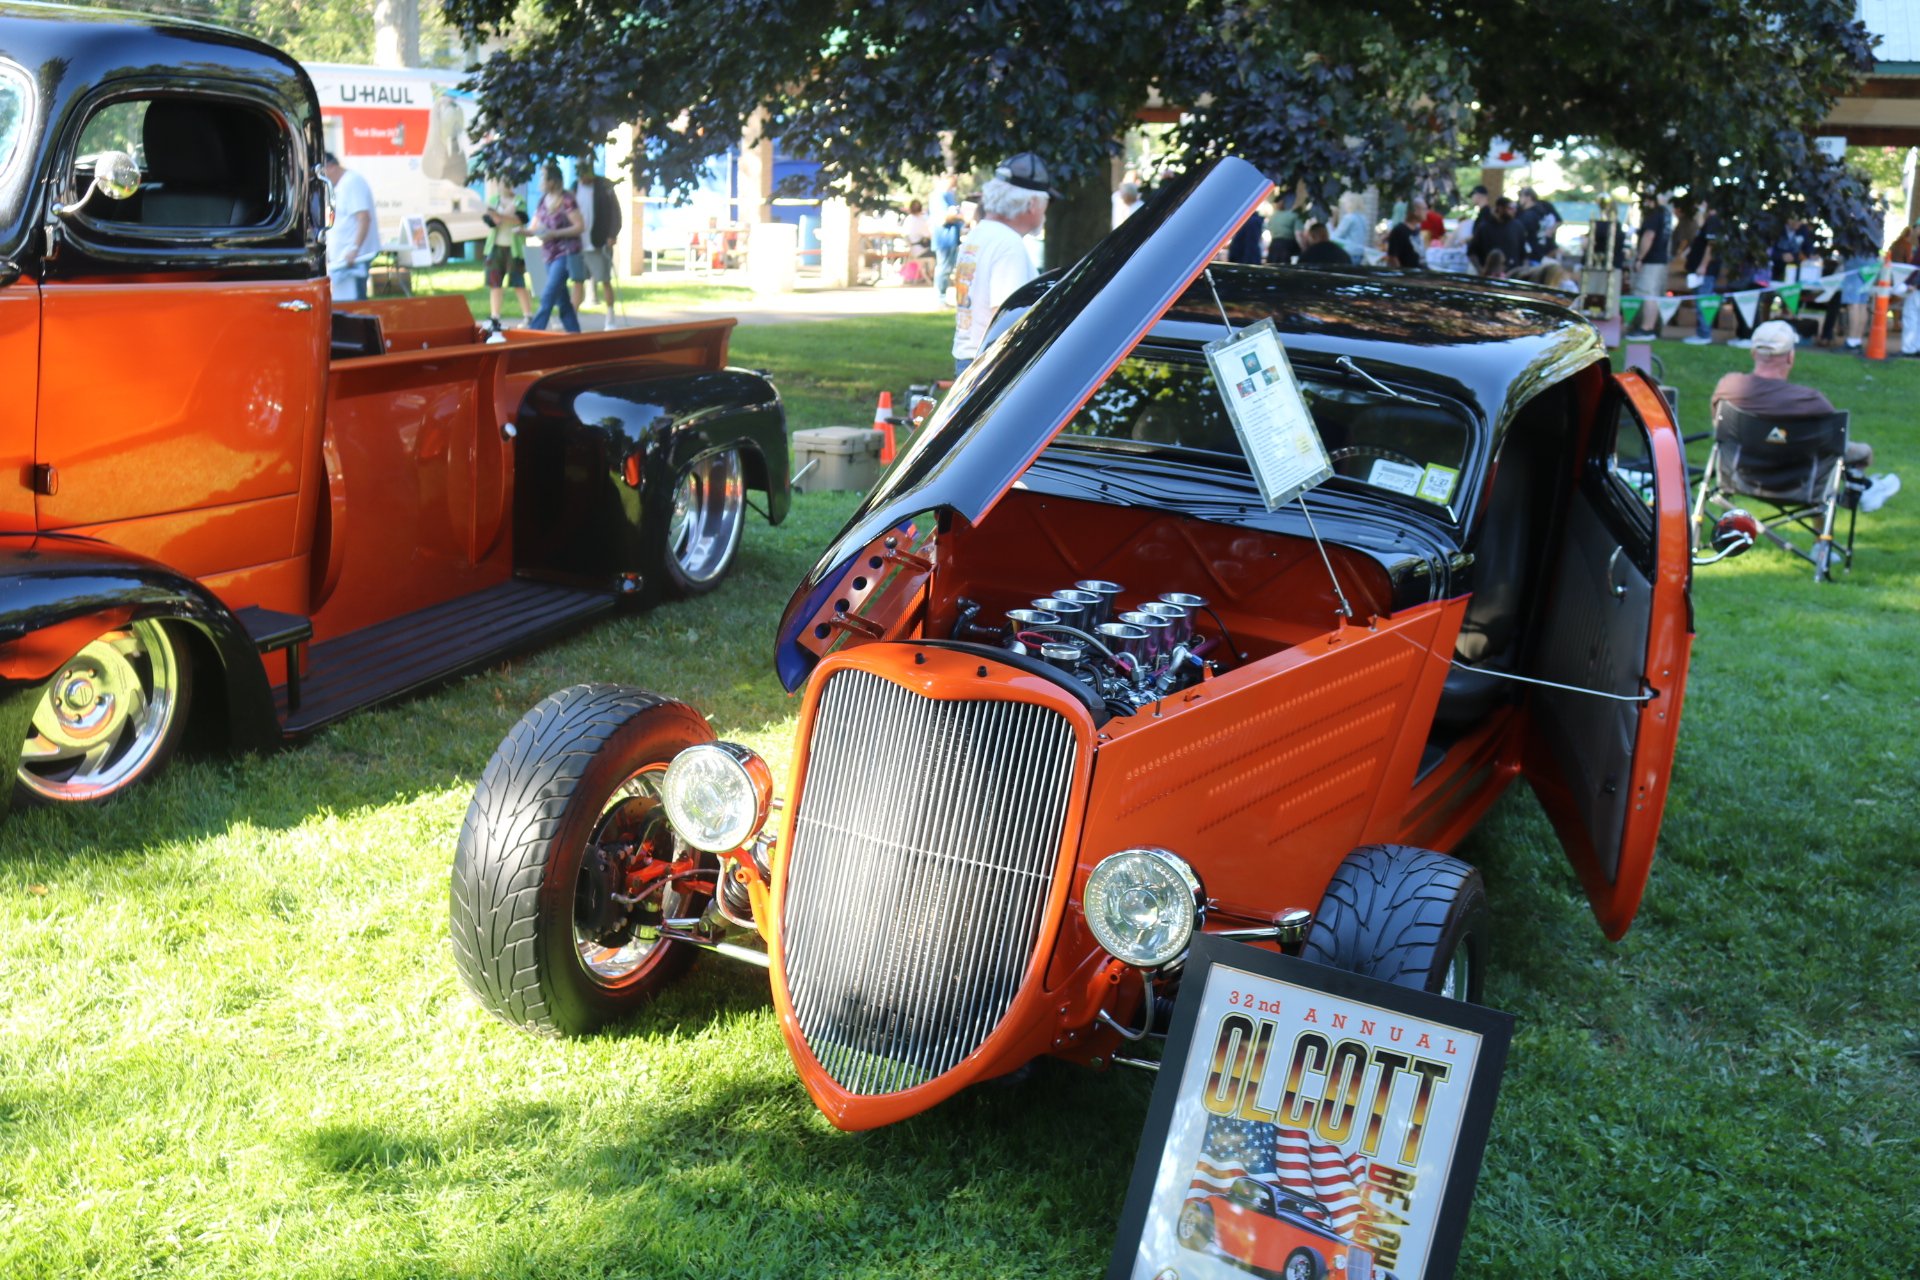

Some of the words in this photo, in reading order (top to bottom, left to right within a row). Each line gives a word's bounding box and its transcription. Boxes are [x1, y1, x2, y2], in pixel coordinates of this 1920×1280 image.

[340, 84, 414, 104] U-HAUL
[1229, 990, 1281, 1015] 32nd
[1303, 1007, 1457, 1055] ANNUAL
[1202, 1012, 1452, 1167] OLCOTT
[1352, 1162, 1418, 1271] BEACH
